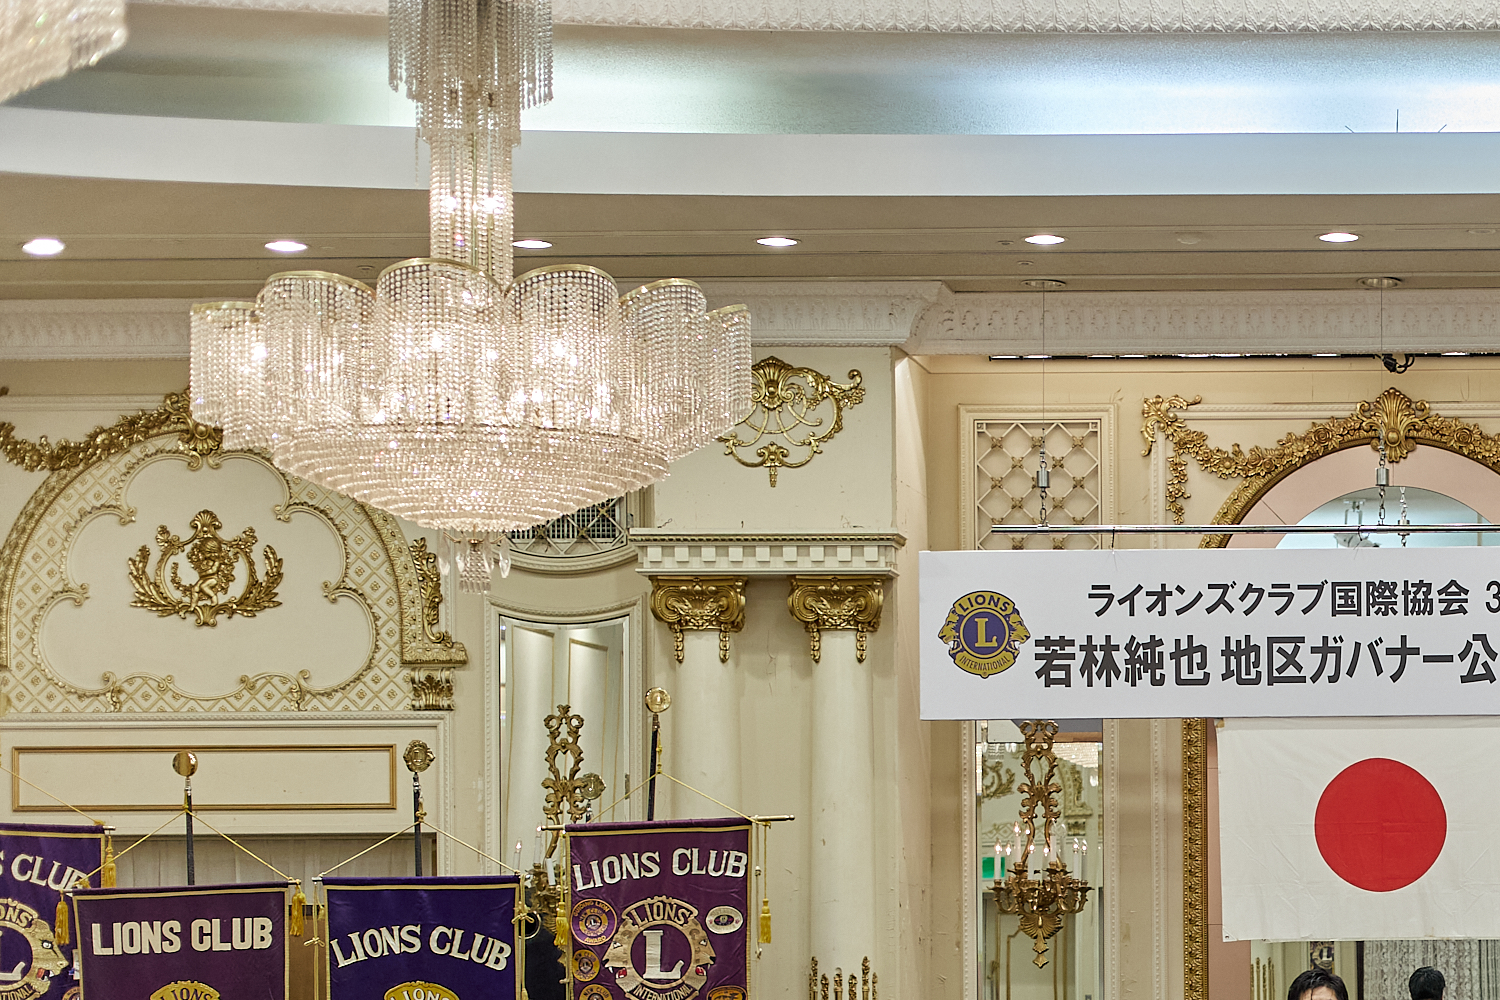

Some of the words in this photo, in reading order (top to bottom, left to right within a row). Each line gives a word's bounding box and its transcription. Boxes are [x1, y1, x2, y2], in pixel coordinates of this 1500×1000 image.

[958, 594, 1010, 613] LIONS
[1087, 579, 1470, 618] ライオンズクラブ国際協会
[974, 617, 998, 648] L
[959, 655, 1010, 671] INTERNATIONAL
[572, 851, 661, 892] LIONS
[671, 847, 748, 878] CLUB
[631, 901, 691, 929] LIONS
[92, 921, 181, 956] LIONS
[191, 917, 273, 952] CLUB
[329, 924, 422, 969] LIONS
[429, 925, 512, 971] CLUB
[642, 929, 685, 980] L
